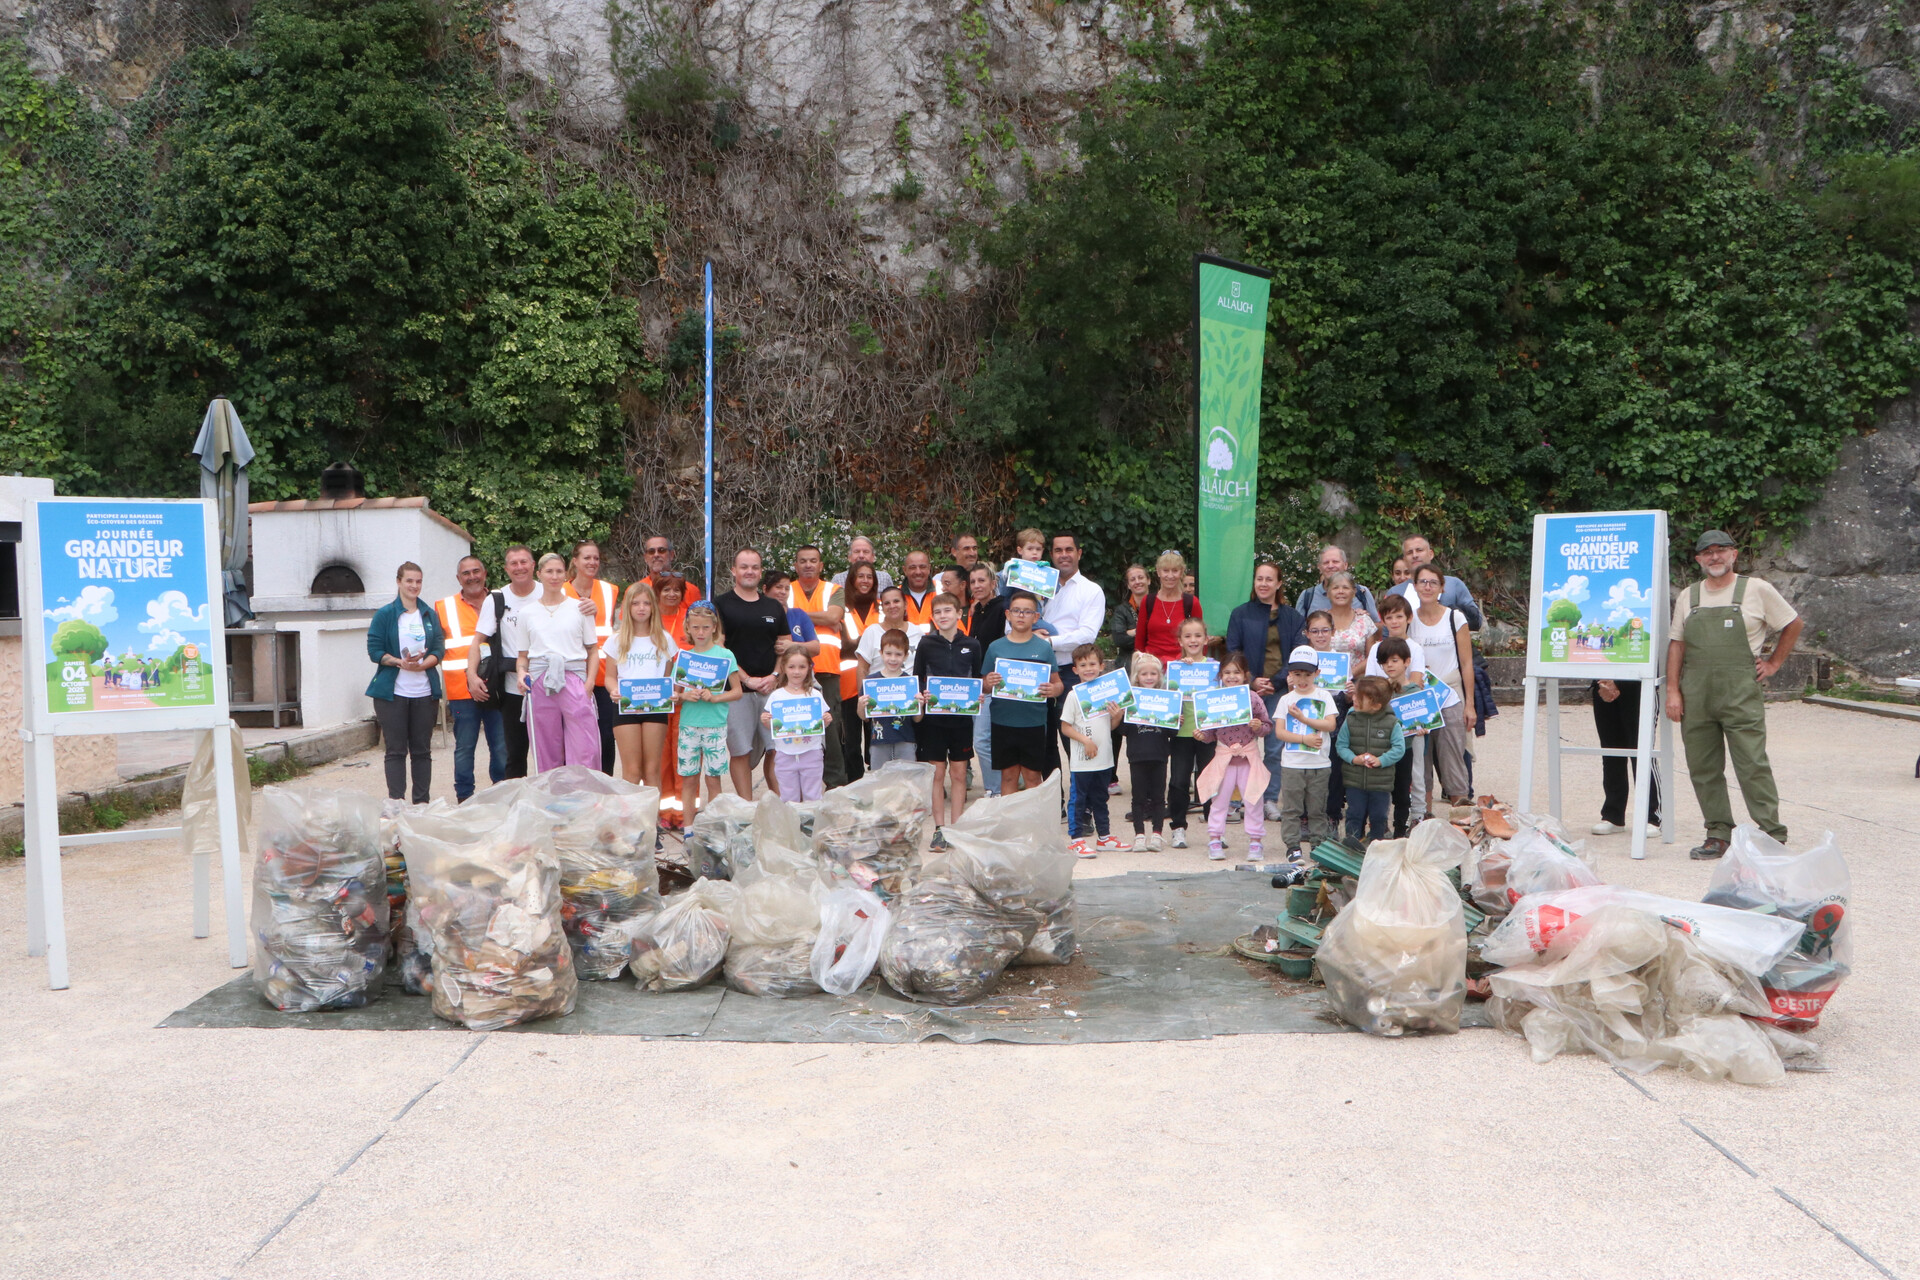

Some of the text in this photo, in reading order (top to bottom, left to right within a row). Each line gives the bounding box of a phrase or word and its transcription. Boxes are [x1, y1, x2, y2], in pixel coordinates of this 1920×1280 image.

[1217, 295, 1253, 314] ALLAUCH
[1200, 475, 1250, 497] ALLAUCH
[95, 527, 154, 539] JOURNÉE
[1580, 533, 1619, 543] JOURNÉE
[64, 539, 184, 558] GRANDEUR
[1560, 541, 1639, 556] GRANDEUR
[78, 557, 174, 579] NATURE
[1567, 554, 1630, 571] NATURE
[1550, 631, 1567, 642] 04
[688, 660, 719, 671] DIPLÔME
[1319, 658, 1337, 667] LÔME
[62, 666, 88, 681] 04
[1007, 668, 1038, 677] DIPLÔME
[1180, 668, 1209, 677] DIPLÔME
[631, 684, 661, 692] DIPLÔME
[876, 683, 907, 693] DIPLÔME
[940, 683, 970, 692] DIPLÔME
[1087, 679, 1117, 694] DIPLÔME
[1140, 694, 1170, 704] DIPLÔME
[1207, 694, 1237, 704] DIPLÔME
[782, 703, 812, 714] DIPLÔME
[1399, 699, 1427, 712] DIPLÔME
